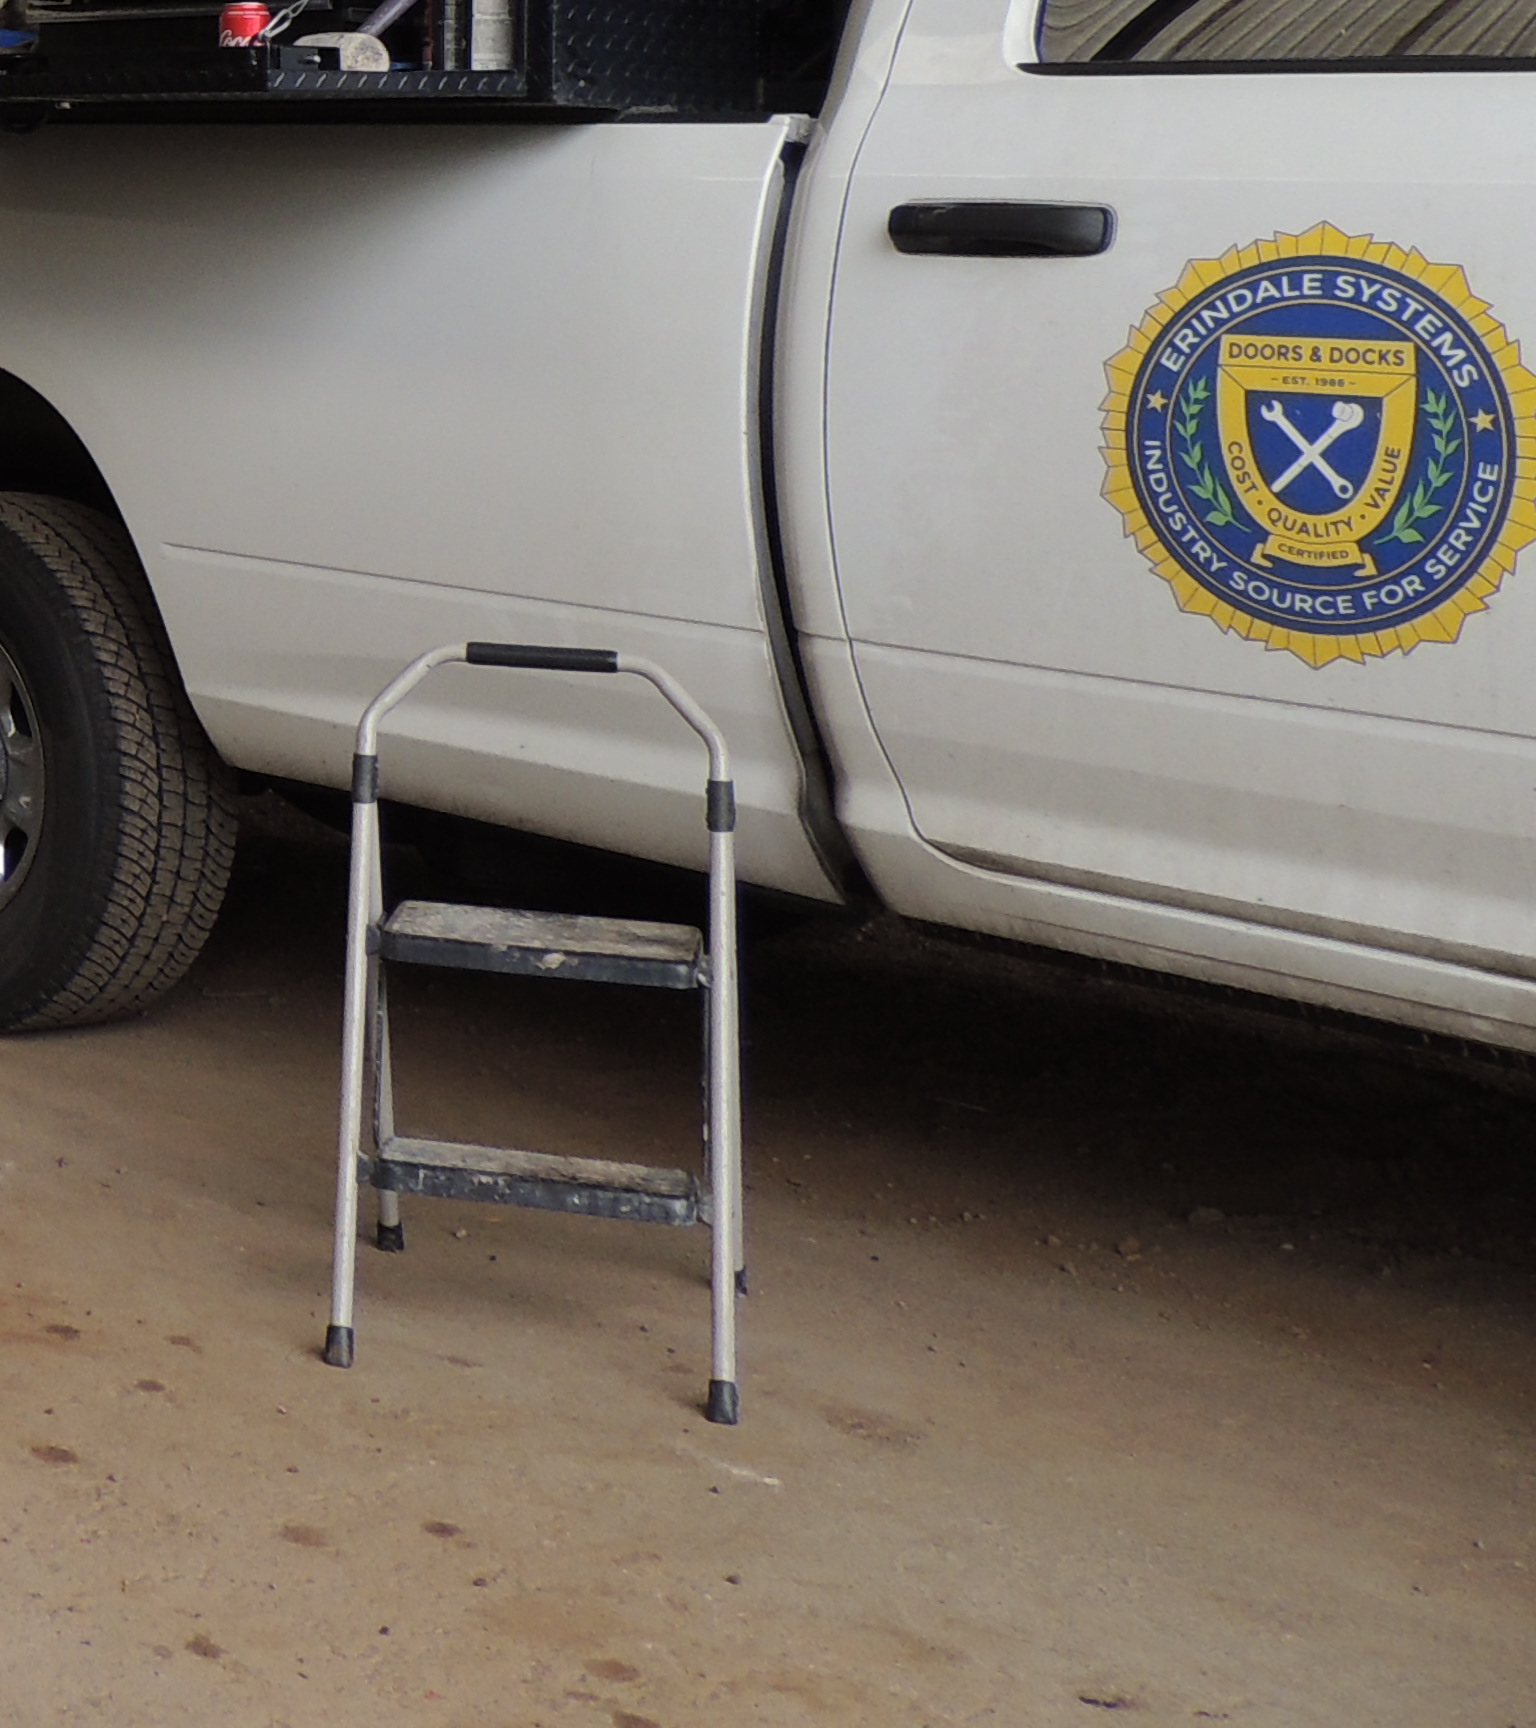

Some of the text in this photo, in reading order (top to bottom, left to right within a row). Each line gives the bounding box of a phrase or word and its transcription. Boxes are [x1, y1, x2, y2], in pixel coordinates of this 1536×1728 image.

[1160, 272, 1480, 389] ERINDALE SYSTEMS
[1228, 341, 1406, 367] DOORS & DOCKS
[1282, 375, 1310, 386] EST.
[1225, 439, 1402, 540] COST QUALITY VALUE
[1141, 438, 1500, 616] INDUSTRY SOURCE FOR SERVICE
[1277, 542, 1350, 561] CERTIFIED
